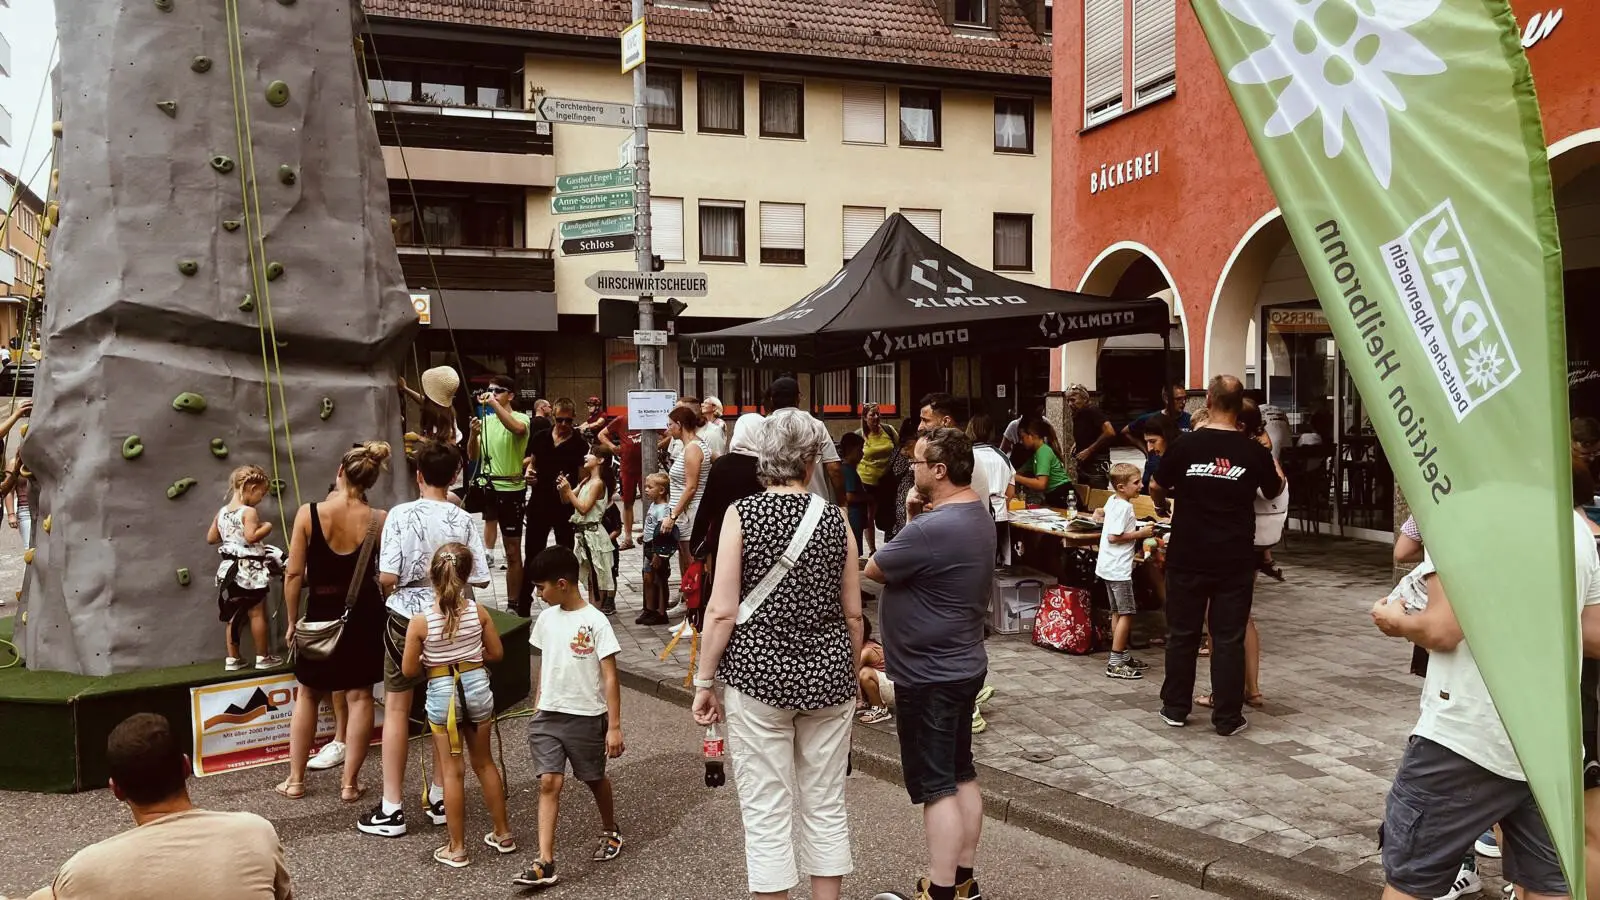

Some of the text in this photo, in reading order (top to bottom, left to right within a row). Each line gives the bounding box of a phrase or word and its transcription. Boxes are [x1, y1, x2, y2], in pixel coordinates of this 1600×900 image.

[556, 112, 596, 123] Ingelfingen
[1090, 150, 1159, 194] BÄCKEREI
[566, 173, 613, 185] Gasthof Engel
[558, 194, 608, 206] Anne-Sophie
[580, 240, 615, 251] Schloss
[597, 276, 706, 291] HIRSCHWIRTSCHEUER
[907, 295, 1028, 308] XLMOTO
[1068, 311, 1135, 330] XLMOTO
[894, 328, 970, 351] XLMOTO
[700, 343, 725, 356] XLMOTO
[763, 343, 797, 358] XLMOTO
